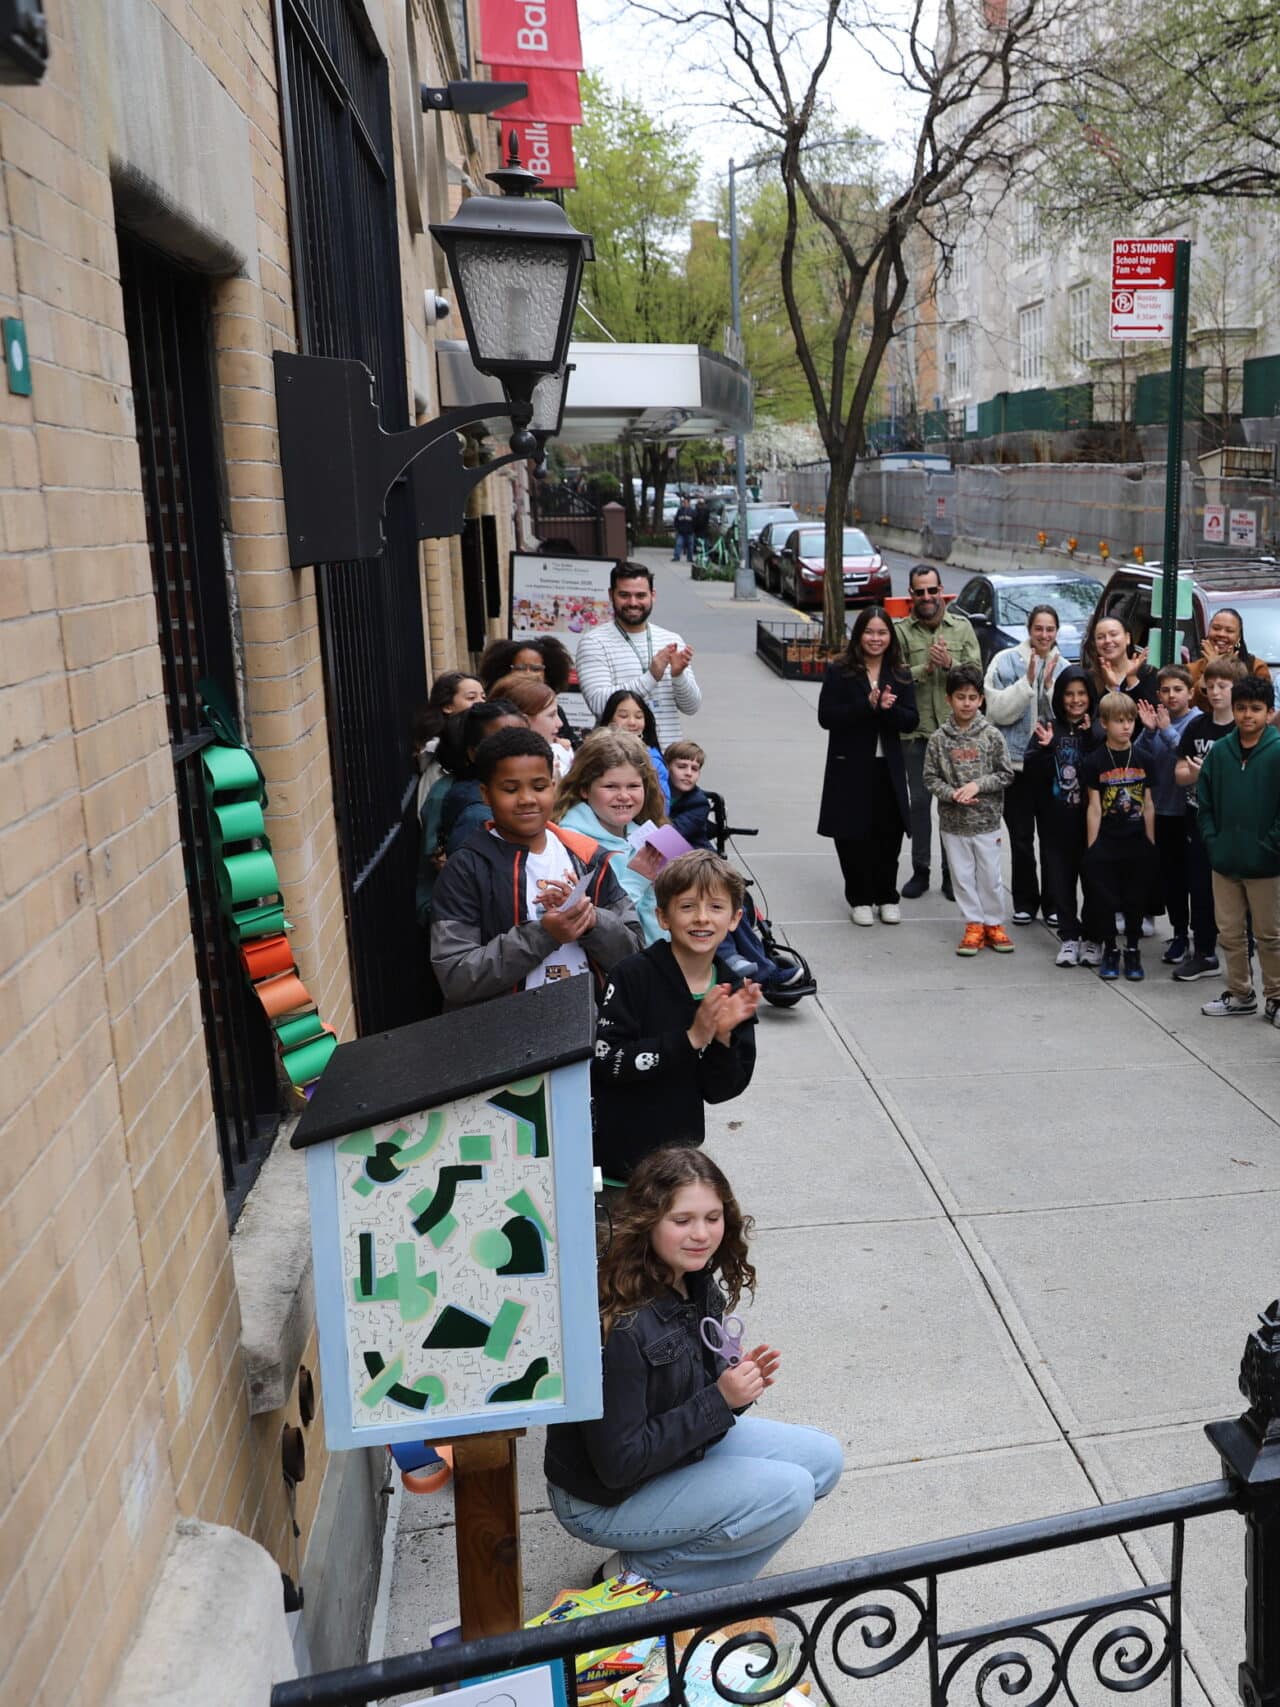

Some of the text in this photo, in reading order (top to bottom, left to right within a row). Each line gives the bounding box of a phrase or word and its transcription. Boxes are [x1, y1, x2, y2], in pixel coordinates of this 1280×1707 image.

[1116, 243, 1174, 253] NO STANDING
[1115, 256, 1157, 266] School Days
[1115, 266, 1130, 274] 7am
[1136, 266, 1152, 275] 4pm
